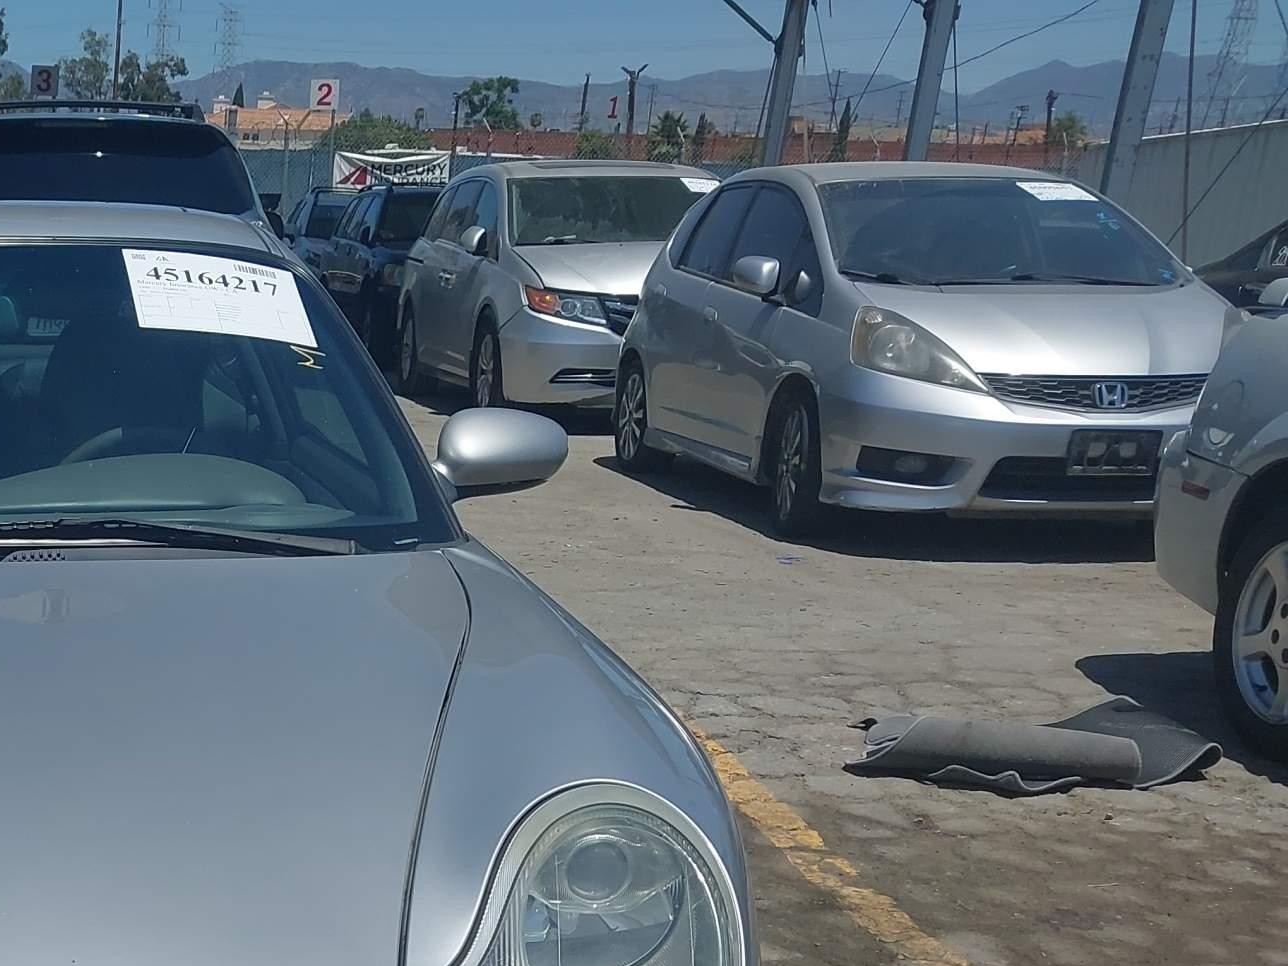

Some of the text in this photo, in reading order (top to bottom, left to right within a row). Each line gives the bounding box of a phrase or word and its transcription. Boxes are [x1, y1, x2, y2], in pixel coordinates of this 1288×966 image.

[36, 69, 52, 92] 3
[316, 83, 333, 106] 2
[607, 95, 619, 119] 1
[371, 163, 447, 177] MERCURY
[146, 266, 277, 297] 45164217
